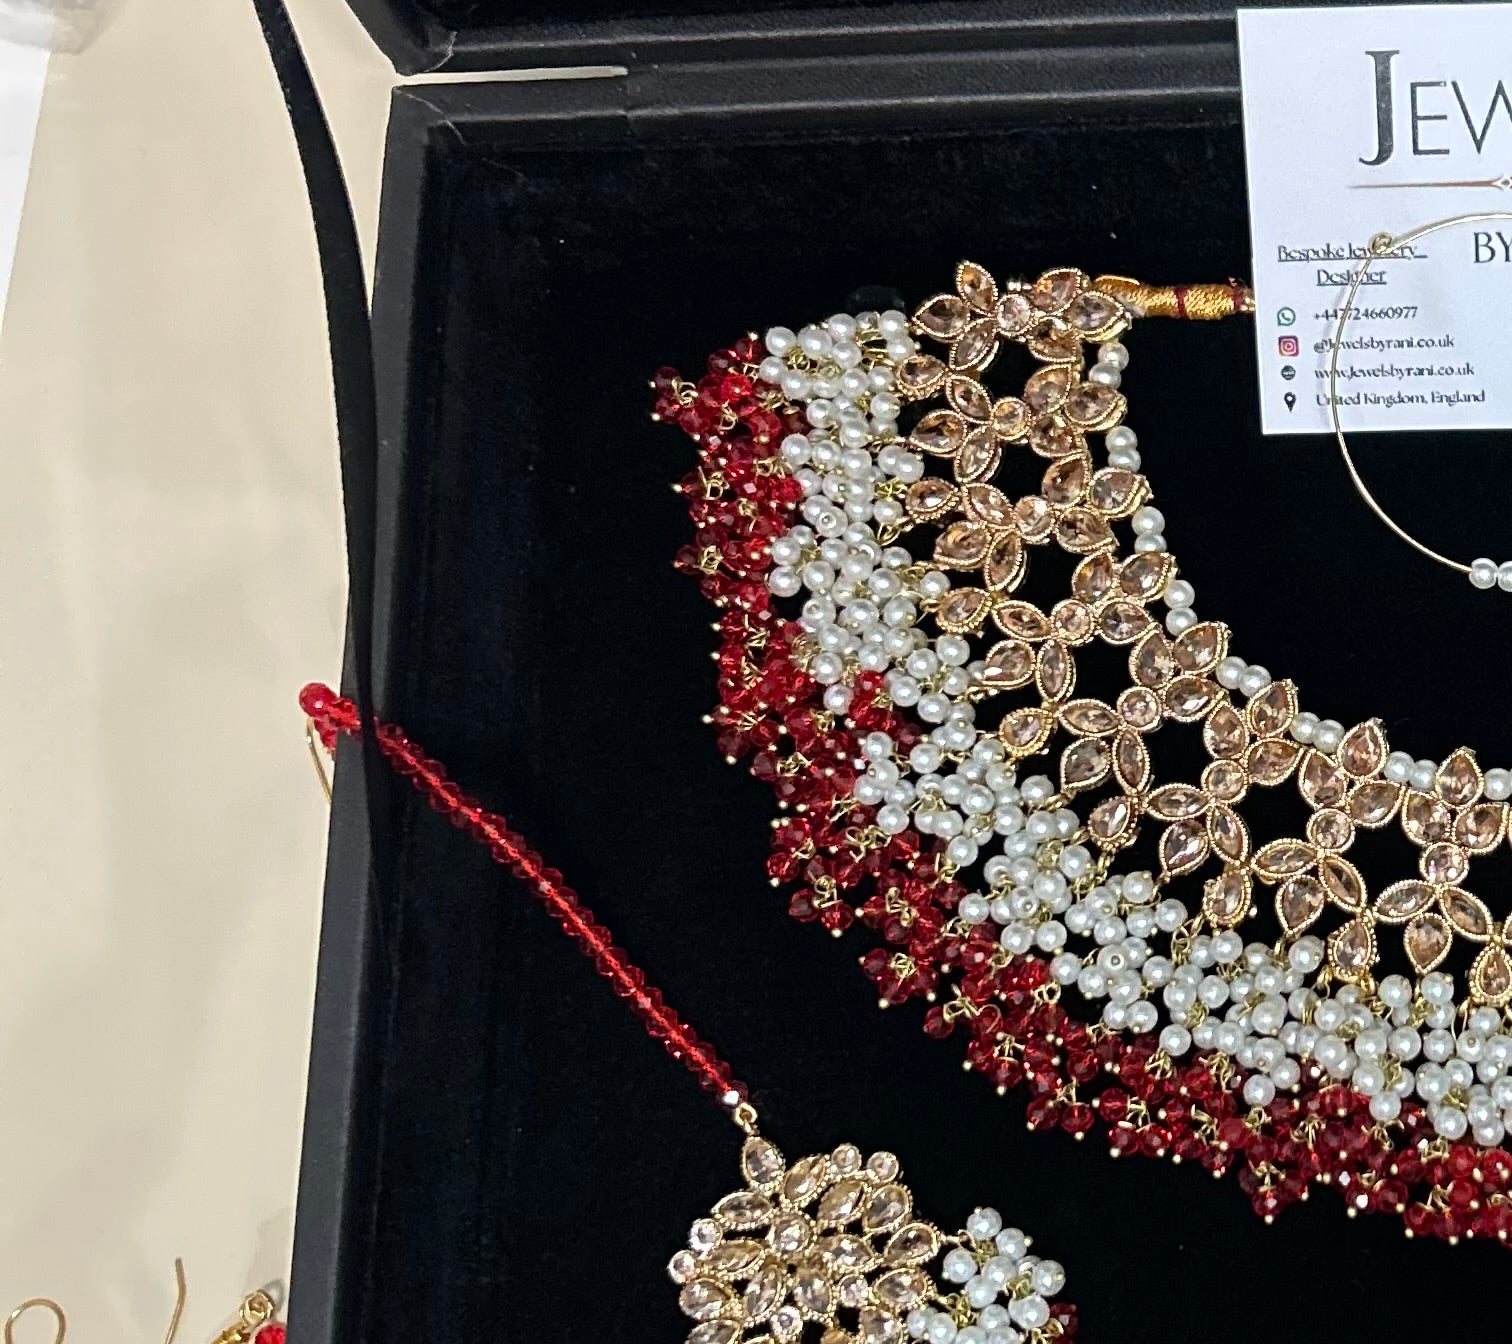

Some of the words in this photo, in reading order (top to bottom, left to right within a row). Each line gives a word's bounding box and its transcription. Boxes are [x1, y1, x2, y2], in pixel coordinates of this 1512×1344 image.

[1277, 242, 1344, 263] Bespoke
[1345, 242, 1417, 261] Jewry
[1364, 391, 1429, 409] Kingdom,
[1431, 389, 1486, 408] England
